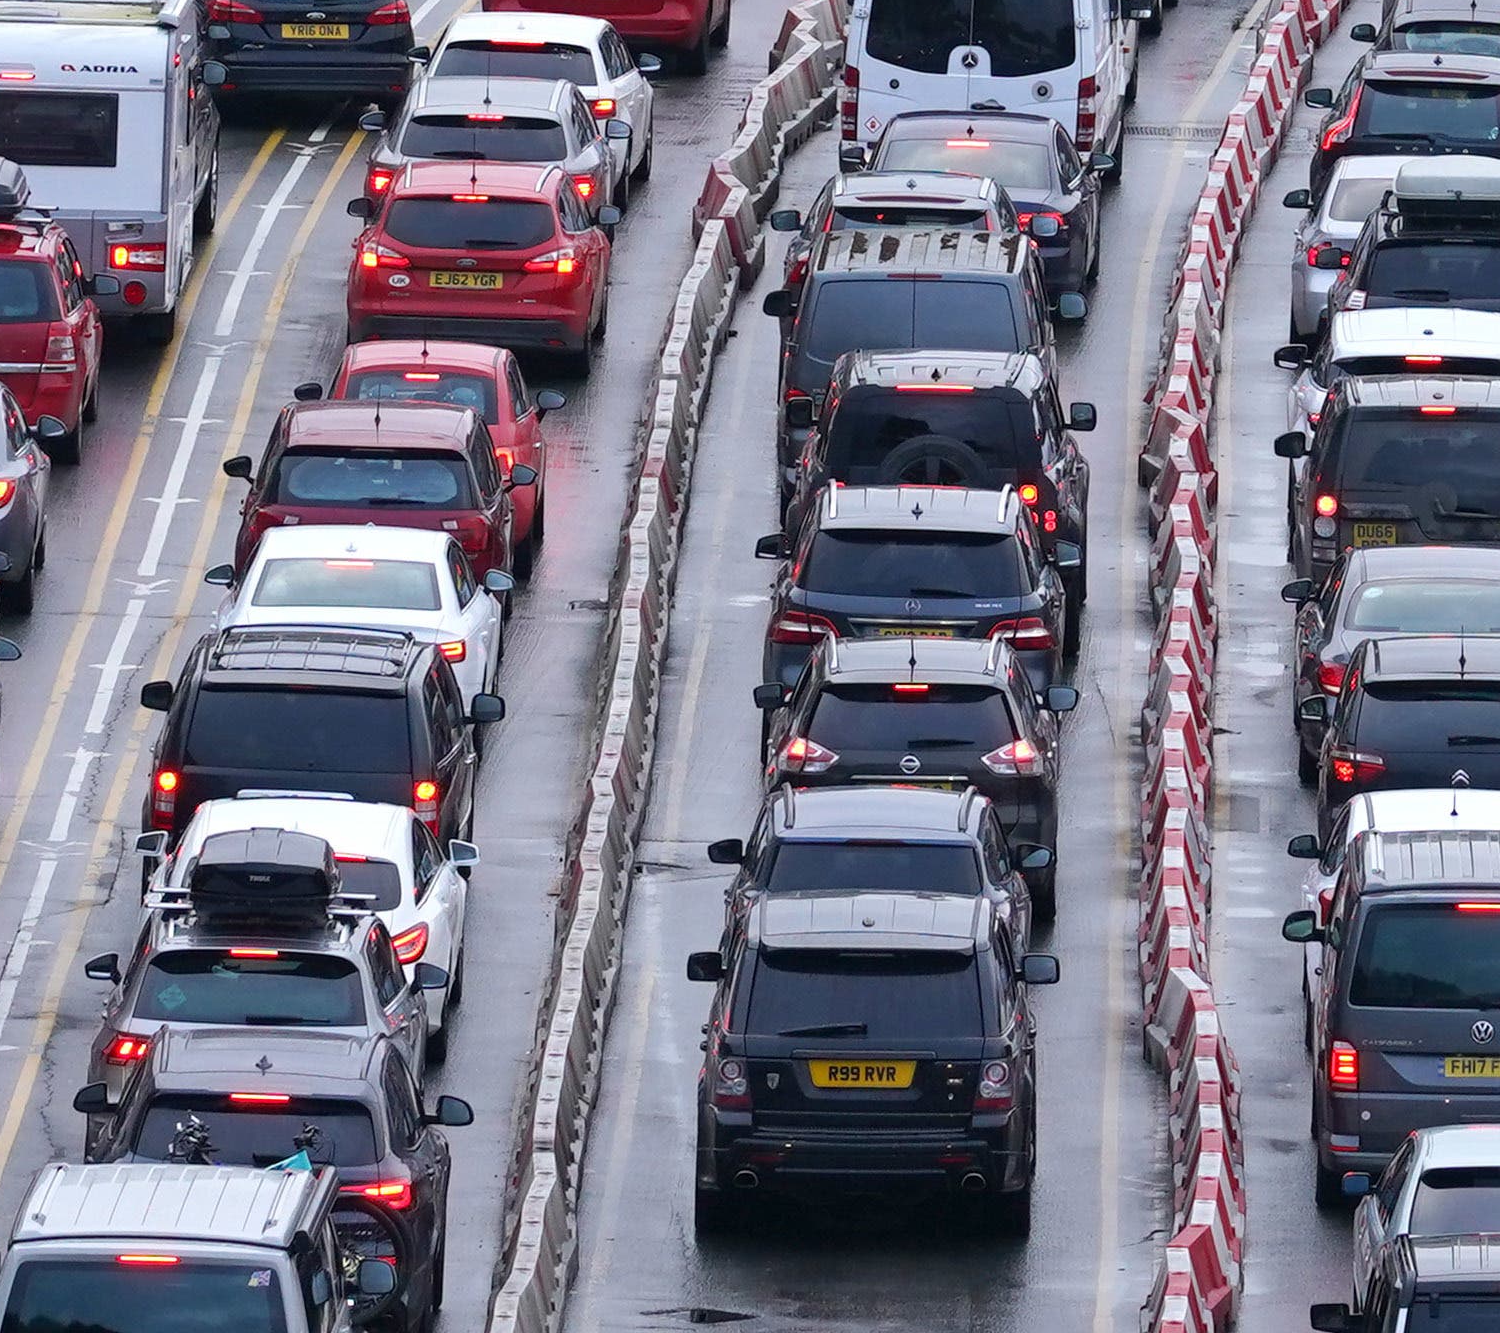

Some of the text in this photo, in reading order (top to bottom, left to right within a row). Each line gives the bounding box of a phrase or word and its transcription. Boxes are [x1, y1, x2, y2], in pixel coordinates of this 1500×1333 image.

[290, 24, 316, 37] YR16
[80, 65, 138, 74] ADRIA
[391, 276, 406, 285] UK
[433, 272, 497, 287] EJ62 YGR
[1357, 524, 1394, 539] DU66
[828, 1065, 897, 1083] R99 RVR
[1450, 1060, 1486, 1075] FH17
